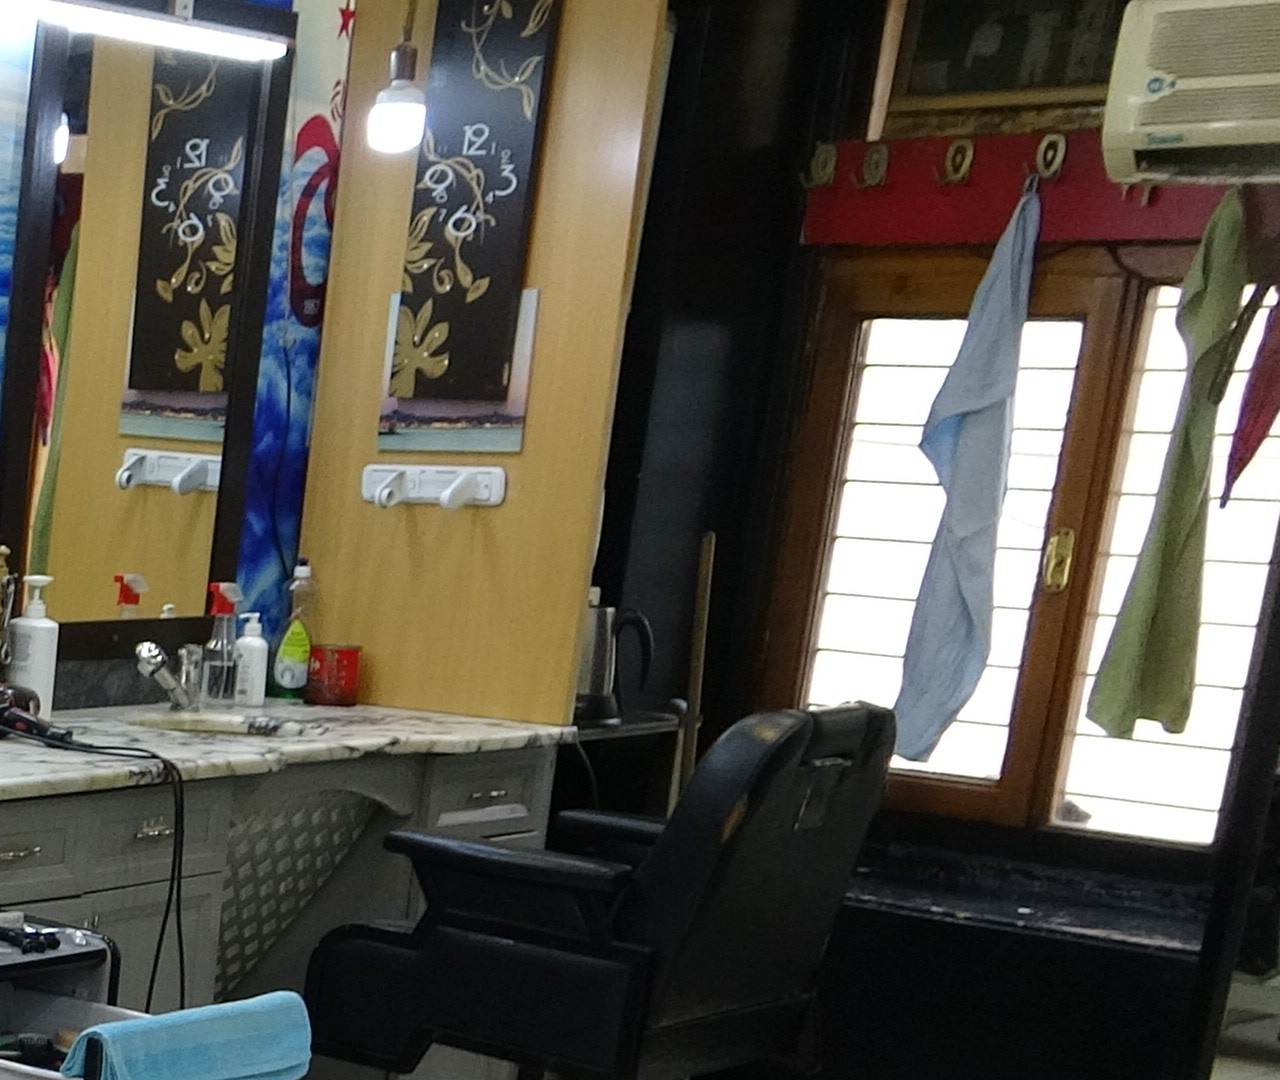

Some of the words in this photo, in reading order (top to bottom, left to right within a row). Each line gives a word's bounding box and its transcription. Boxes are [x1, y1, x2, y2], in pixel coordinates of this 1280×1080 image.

[463, 122, 490, 155] 12
[425, 163, 453, 197] 9
[494, 164, 518, 196] 3
[448, 204, 477, 237] 6
